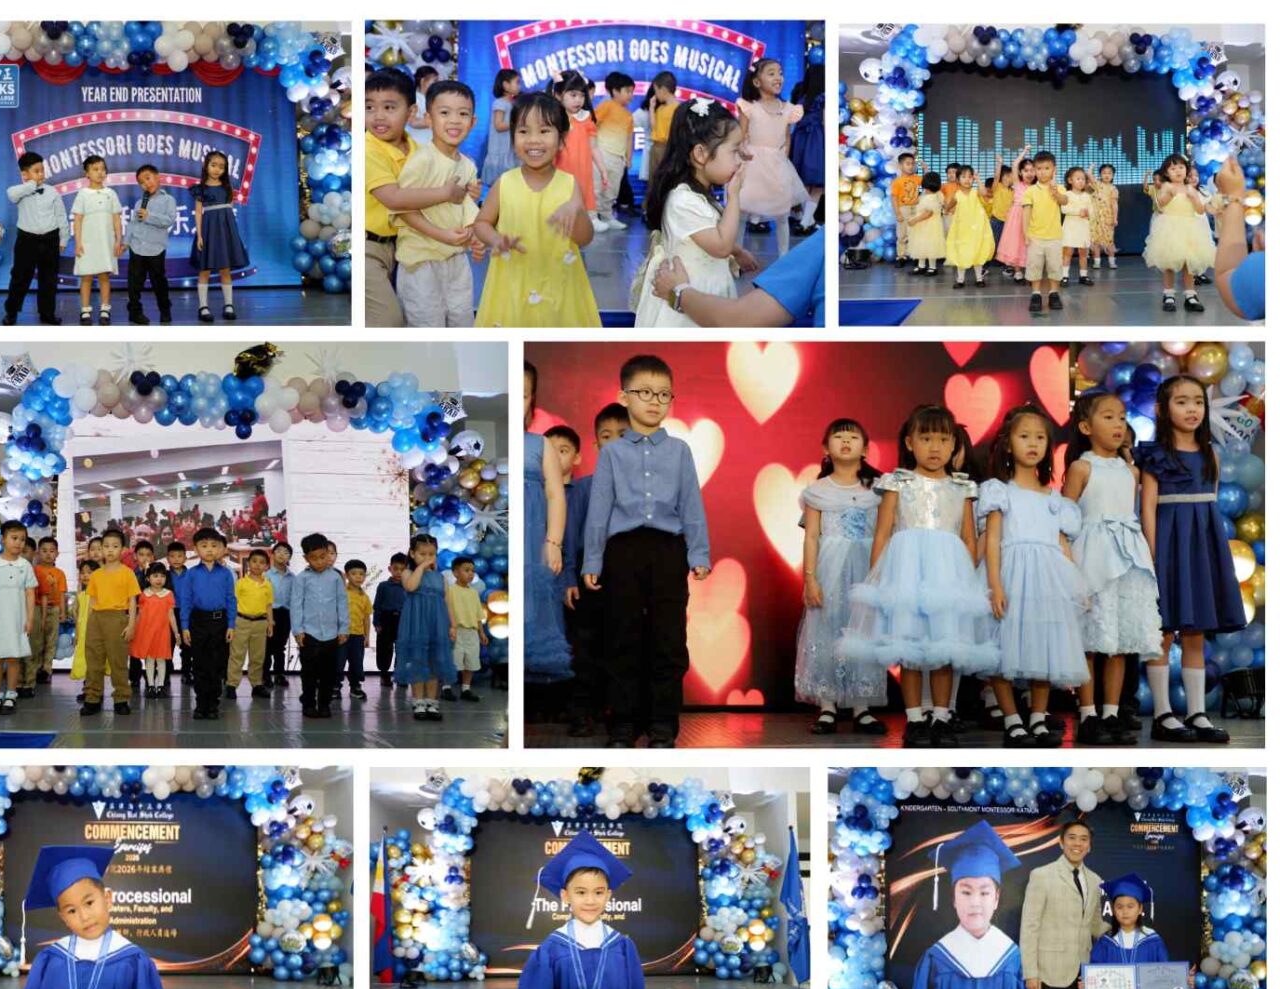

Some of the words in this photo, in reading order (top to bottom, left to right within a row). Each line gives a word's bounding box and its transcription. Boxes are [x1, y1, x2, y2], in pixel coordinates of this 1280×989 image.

[520, 39, 624, 88] MONTESSORI
[629, 39, 669, 64] GOES
[673, 45, 741, 93] MUSICAL
[81, 86, 107, 102] YEAR
[110, 87, 128, 102] END
[131, 87, 202, 103] PRESENTATION
[137, 134, 174, 156] GOES
[84, 824, 180, 840] COMMENCEMENT
[161, 905, 173, 913] and
[534, 898, 558, 911] The
